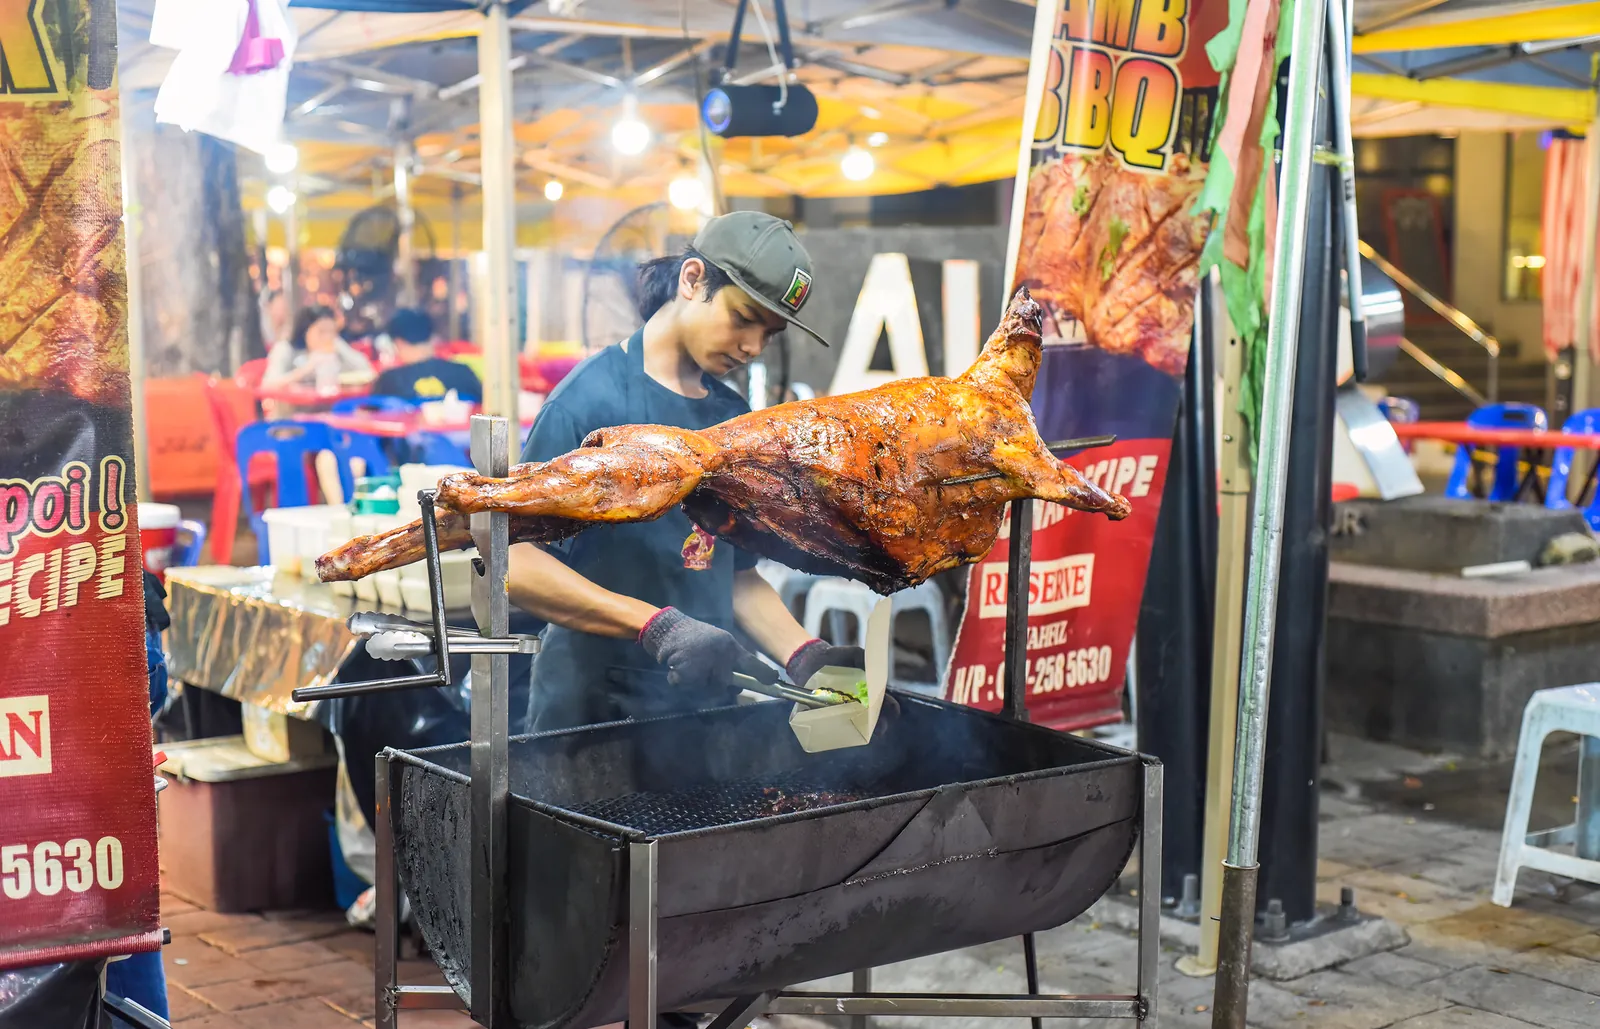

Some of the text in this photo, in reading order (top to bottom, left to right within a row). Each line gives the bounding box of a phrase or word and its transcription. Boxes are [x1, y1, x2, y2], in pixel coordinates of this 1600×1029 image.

[985, 564, 1087, 606] RSERVE
[0, 710, 43, 761] N
[2, 836, 124, 899] 5630
